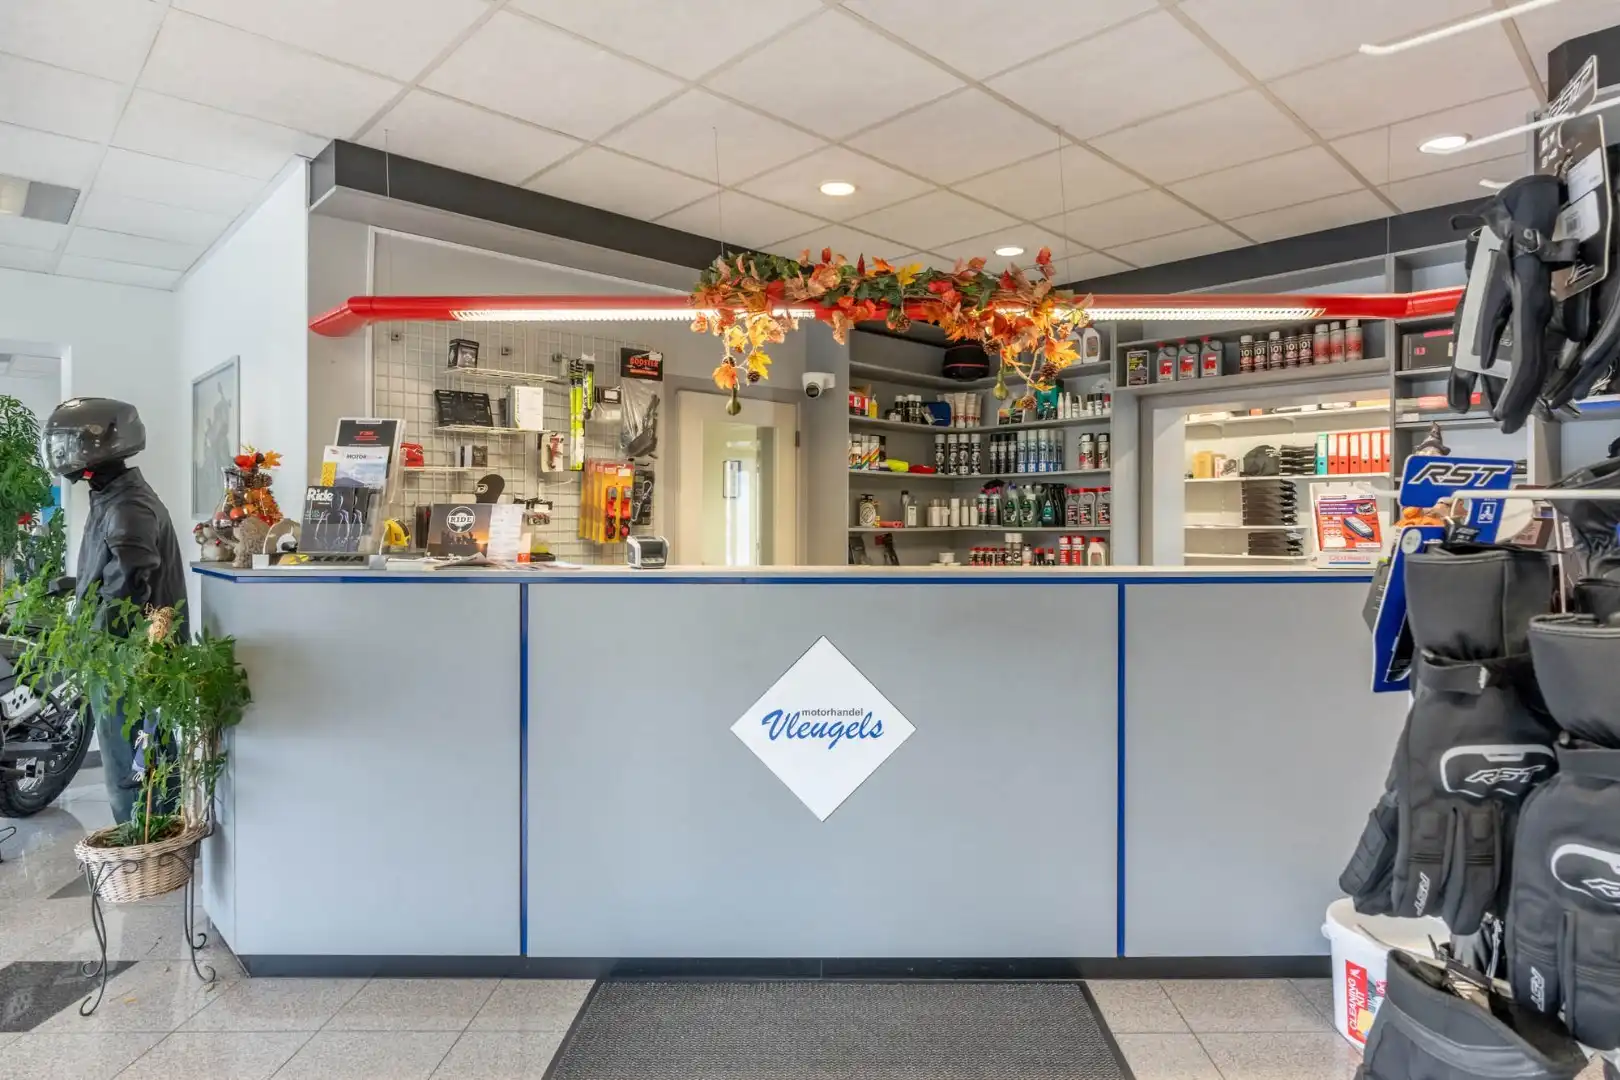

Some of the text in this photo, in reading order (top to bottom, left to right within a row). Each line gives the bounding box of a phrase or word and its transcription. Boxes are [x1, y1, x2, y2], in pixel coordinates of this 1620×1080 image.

[1407, 462, 1513, 487] RST
[307, 488, 334, 501] Ride
[450, 515, 473, 523] RIDE
[801, 708, 864, 717] motorhandel
[761, 709, 885, 750] Vleugels
[1464, 765, 1546, 785] RST
[1356, 988, 1366, 1009] KIT
[1530, 966, 1545, 1013] RST
[1347, 977, 1358, 1031] CLEANING
